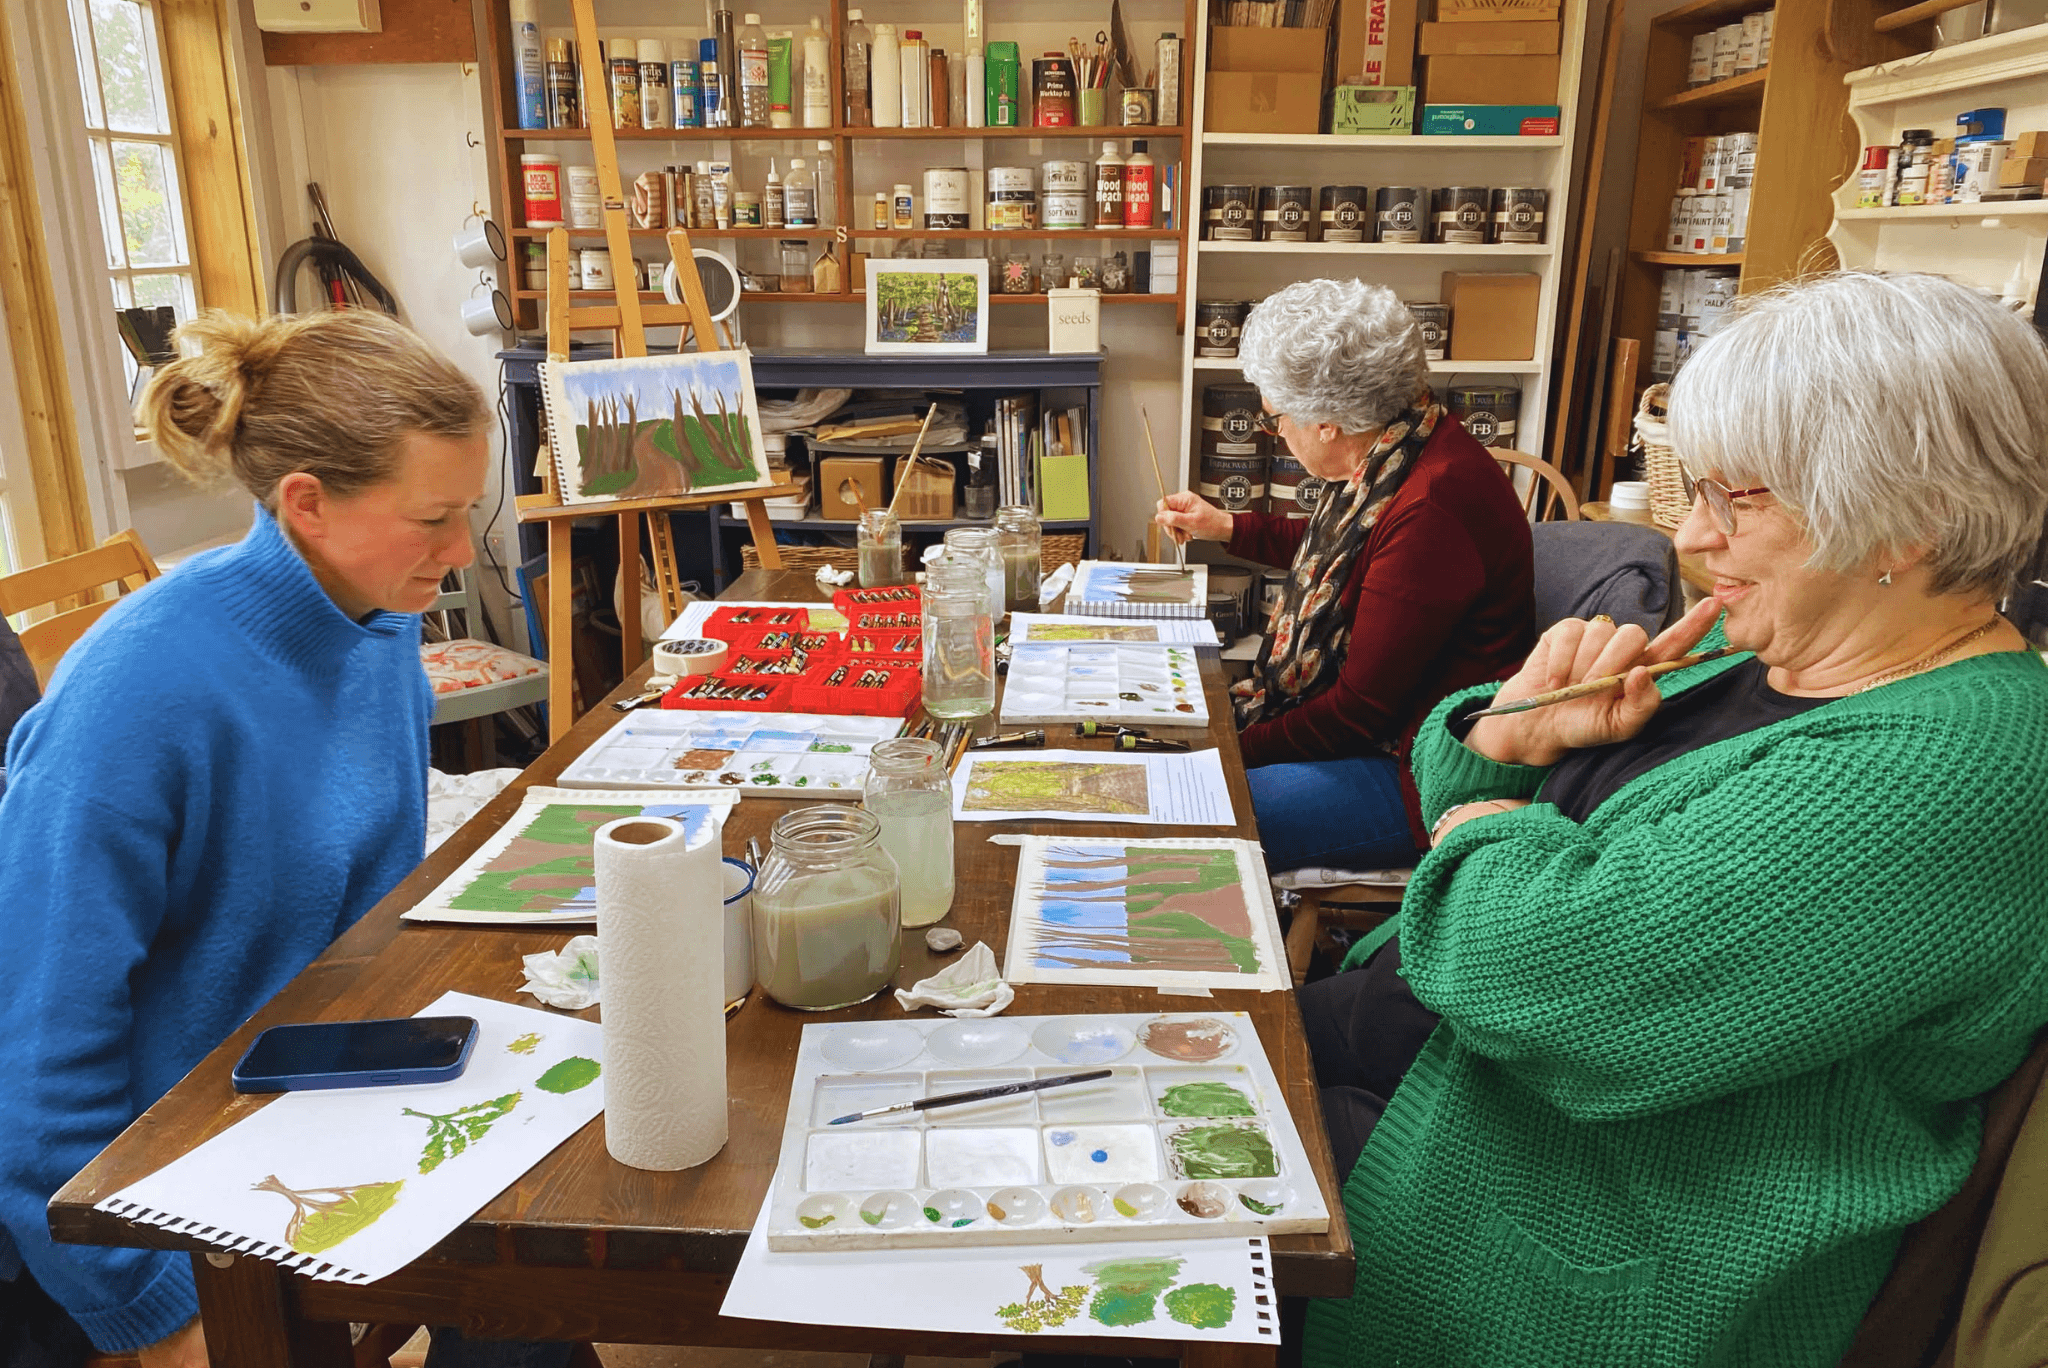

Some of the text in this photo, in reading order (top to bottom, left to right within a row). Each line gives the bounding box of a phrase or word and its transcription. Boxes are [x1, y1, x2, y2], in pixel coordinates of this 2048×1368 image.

[1368, 0, 1387, 46] FRA
[1040, 90, 1062, 98] Worktop
[530, 174, 548, 183] MOD
[1097, 180, 1120, 191] Wood
[1126, 181, 1149, 191] Wood
[1104, 202, 1112, 213] A
[1131, 203, 1139, 213] B
[836, 226, 847, 243] S
[1704, 299, 1724, 307] CHALK
[1058, 311, 1091, 324] seeds
